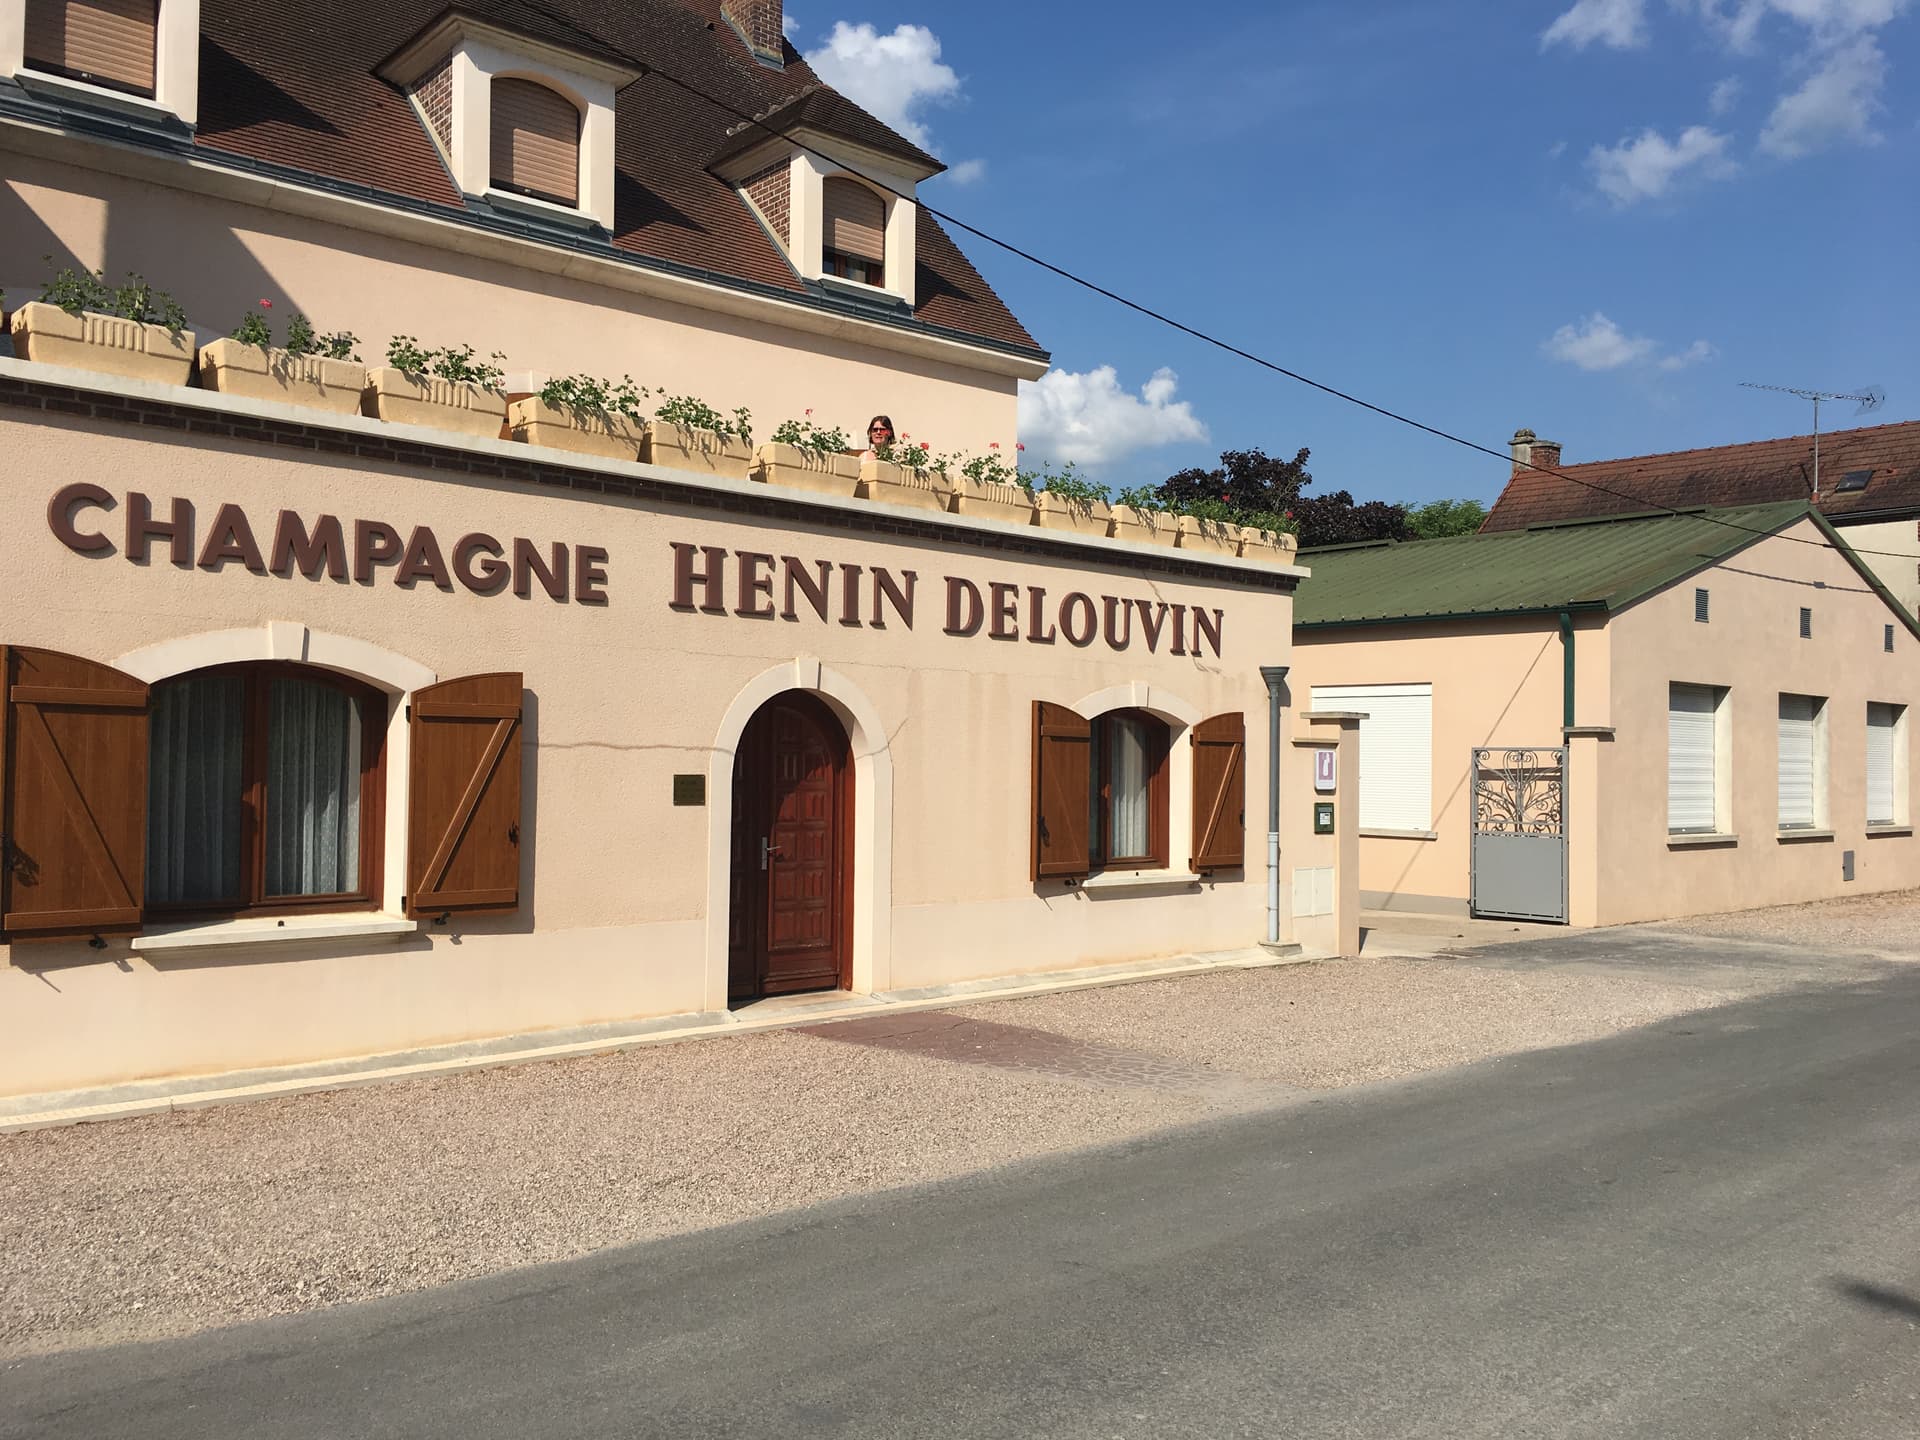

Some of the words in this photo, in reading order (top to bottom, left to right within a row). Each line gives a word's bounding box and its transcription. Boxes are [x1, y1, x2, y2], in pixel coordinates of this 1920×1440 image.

[46, 482, 609, 604] CHAMPAGNE
[669, 541, 917, 631] HENIN
[943, 575, 1224, 658] DELOUVIN
